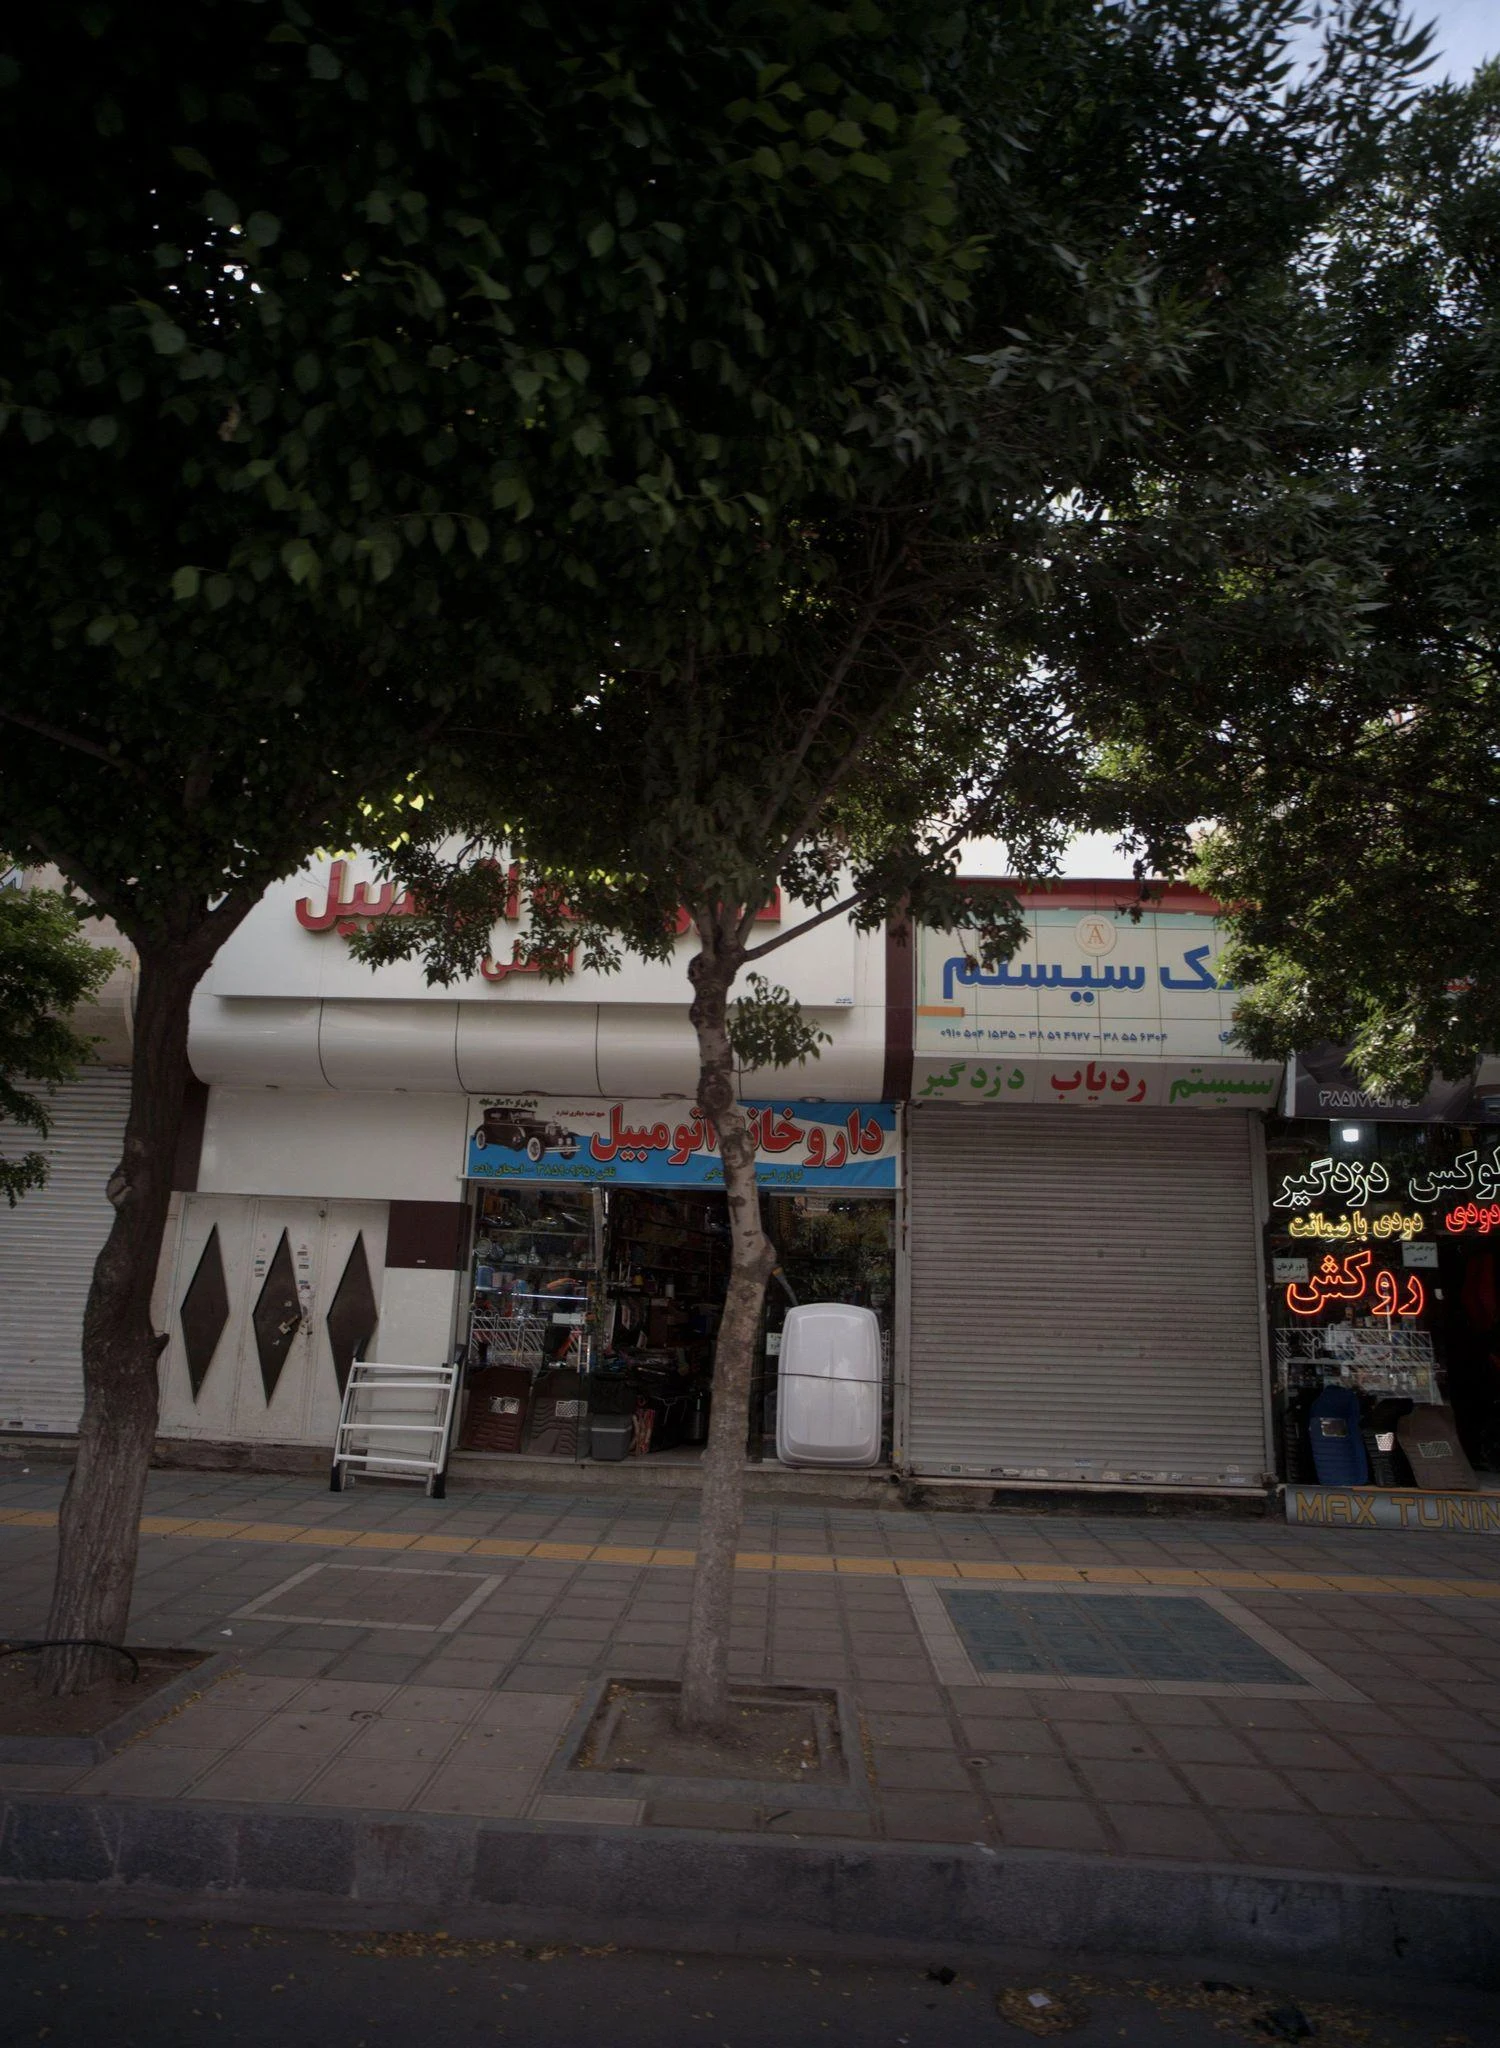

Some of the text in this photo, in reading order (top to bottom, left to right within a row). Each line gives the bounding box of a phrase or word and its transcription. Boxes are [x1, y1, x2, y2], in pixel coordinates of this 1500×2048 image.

[917, 1061, 1274, 1104] سیستم ردیاب دزدگیر
[590, 1102, 716, 1166] اتومبیل
[1272, 1157, 1390, 1208] دزدگیر
[1288, 1210, 1424, 1242] دودی با ضمانت
[1286, 1250, 1424, 1316] روکش
[1295, 1491, 1378, 1526] MAX
